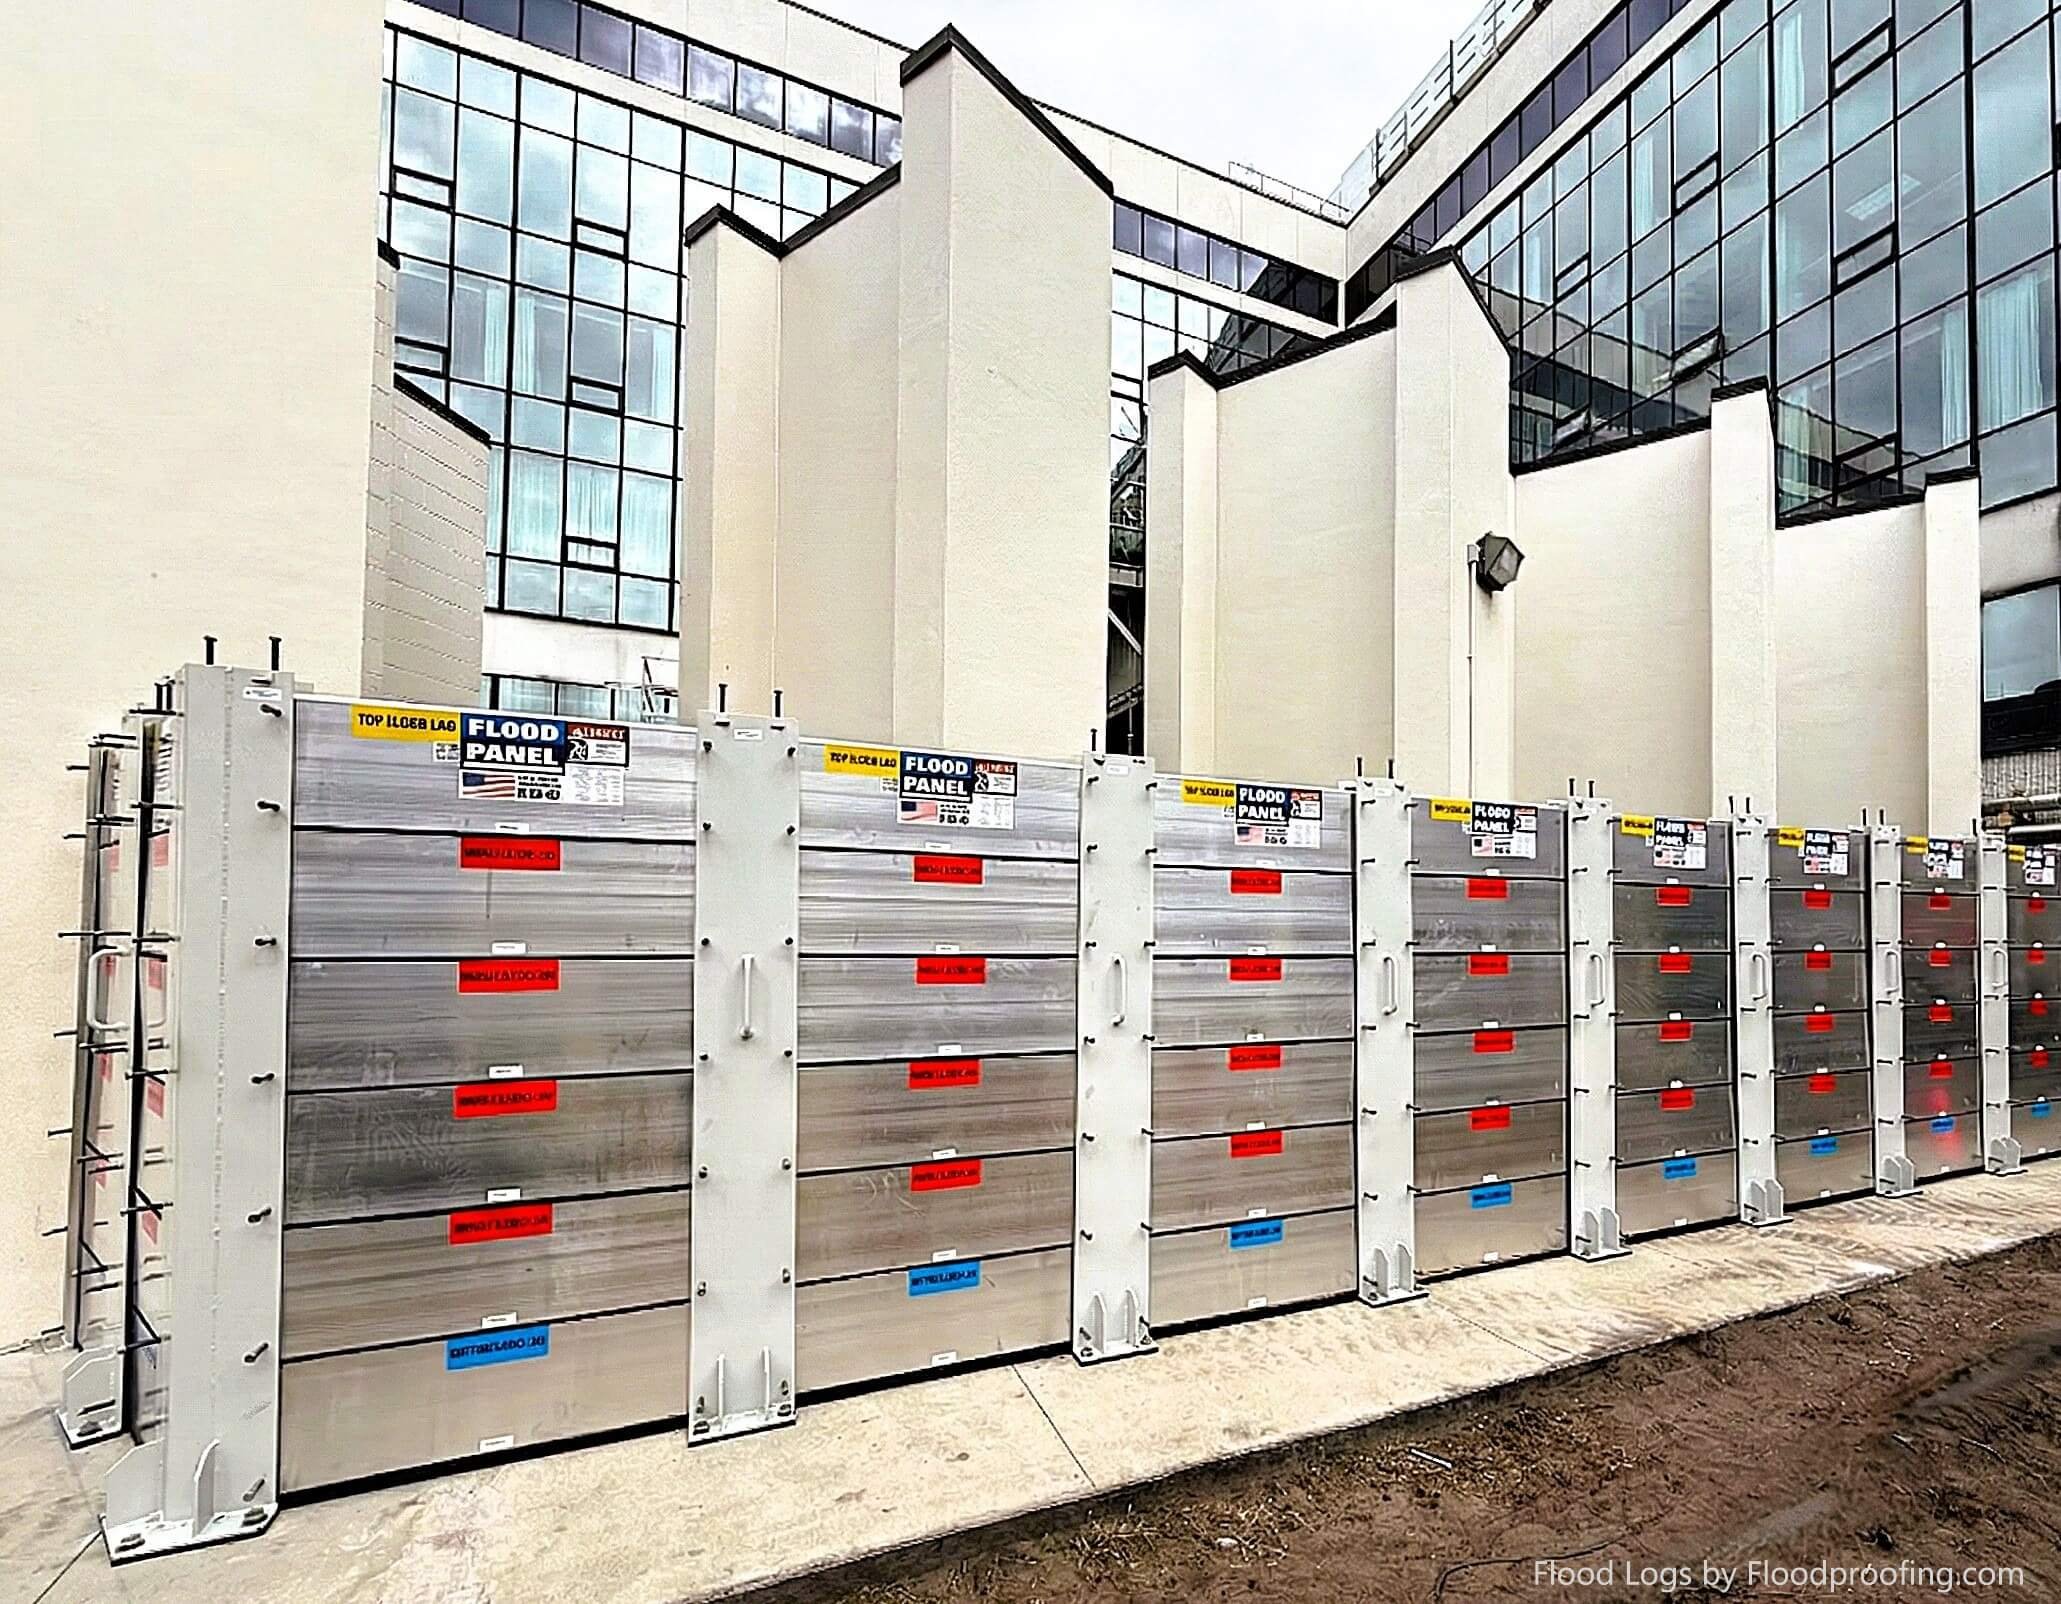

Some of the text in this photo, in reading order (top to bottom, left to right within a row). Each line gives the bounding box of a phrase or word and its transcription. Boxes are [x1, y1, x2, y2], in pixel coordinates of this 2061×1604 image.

[468, 718, 559, 742] FLOOD
[466, 742, 559, 766] PANEL
[905, 756, 969, 776] FLOOD
[903, 775, 968, 796] PANEL
